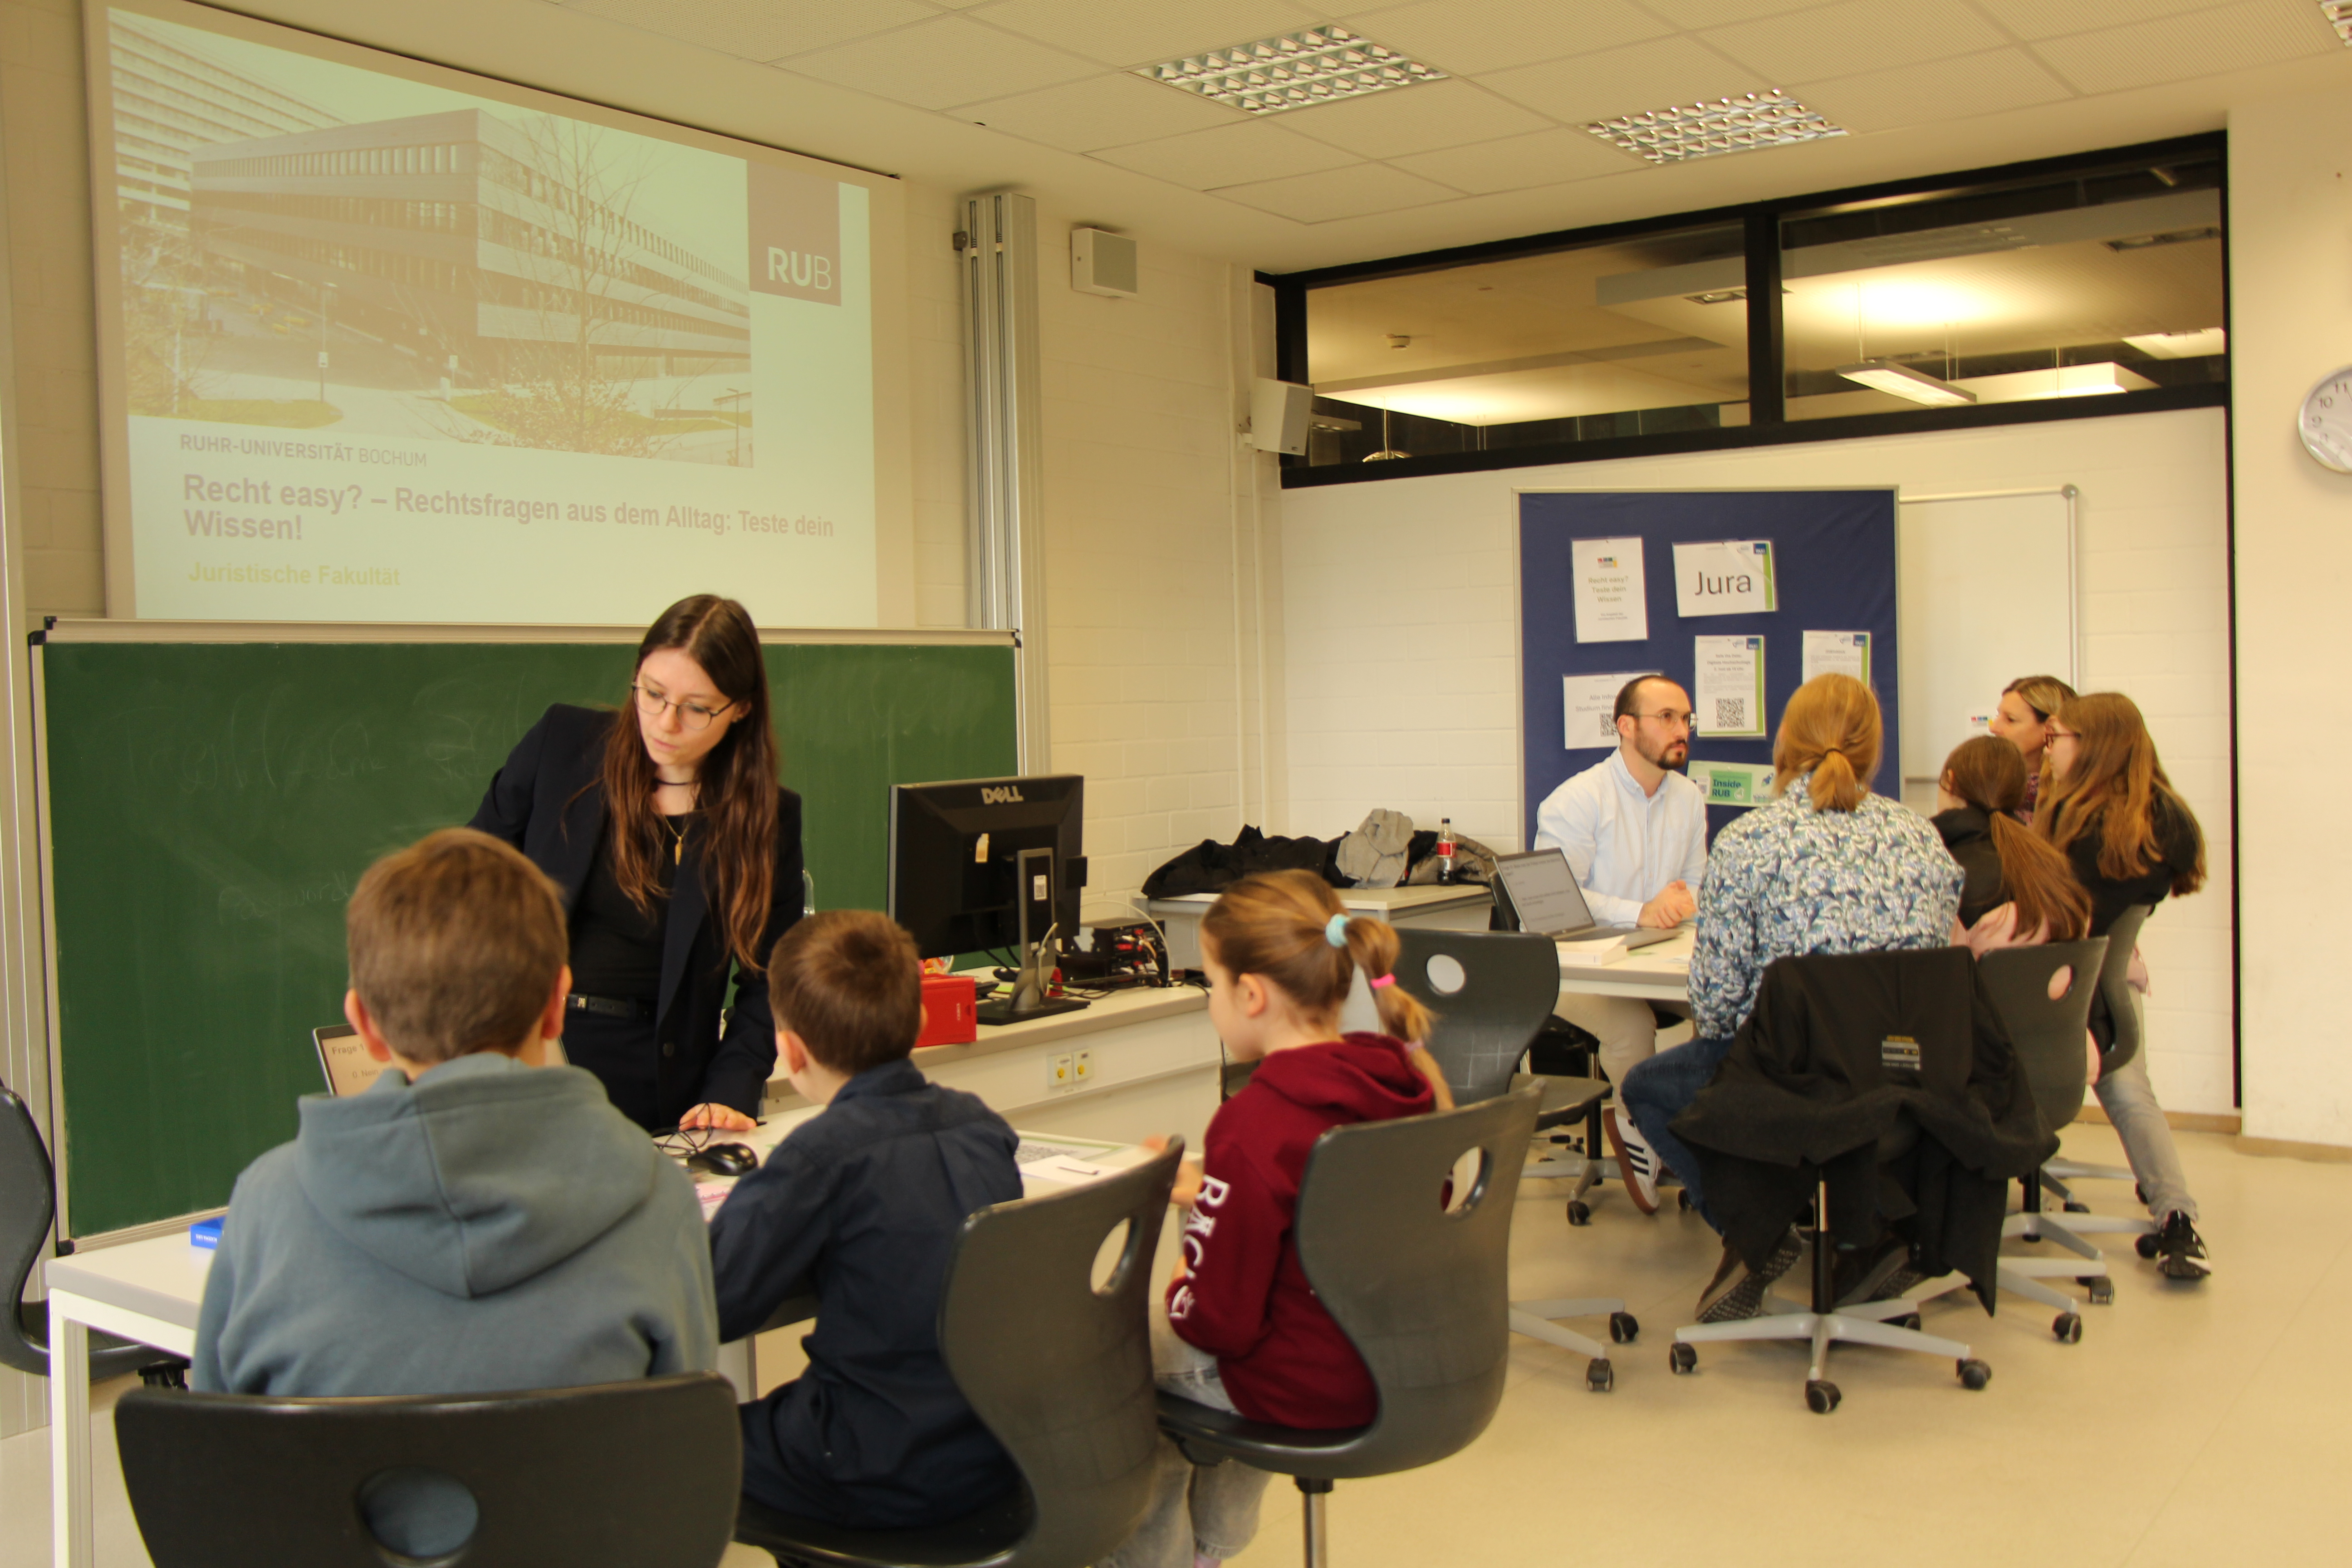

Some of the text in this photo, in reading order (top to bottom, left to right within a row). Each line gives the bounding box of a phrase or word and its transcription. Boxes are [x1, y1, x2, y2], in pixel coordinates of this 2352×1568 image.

[768, 246, 832, 291] RUB
[2319, 396, 2332, 408] 10
[2312, 415, 2322, 428] 9
[181, 434, 428, 467] RUHR-UNIVERSITÄT BOCHUM
[183, 473, 272, 505] Recht
[279, 483, 363, 515] easy?
[396, 487, 560, 524] Rechtsfragen
[566, 502, 607, 524] aus
[613, 502, 660, 526] dem
[665, 505, 731, 536] Alltag:
[738, 510, 789, 534] Teste
[794, 514, 835, 537] dein
[183, 509, 303, 540] Wissen!
[188, 562, 401, 586] Juristische Fakultät
[1588, 575, 1629, 584] Recht easy?
[1694, 571, 1752, 596] Jura
[1712, 789, 1730, 797] RUB
[1713, 779, 1741, 788] Inside
[981, 785, 1024, 804] DELL
[332, 1045, 357, 1054] Frage
